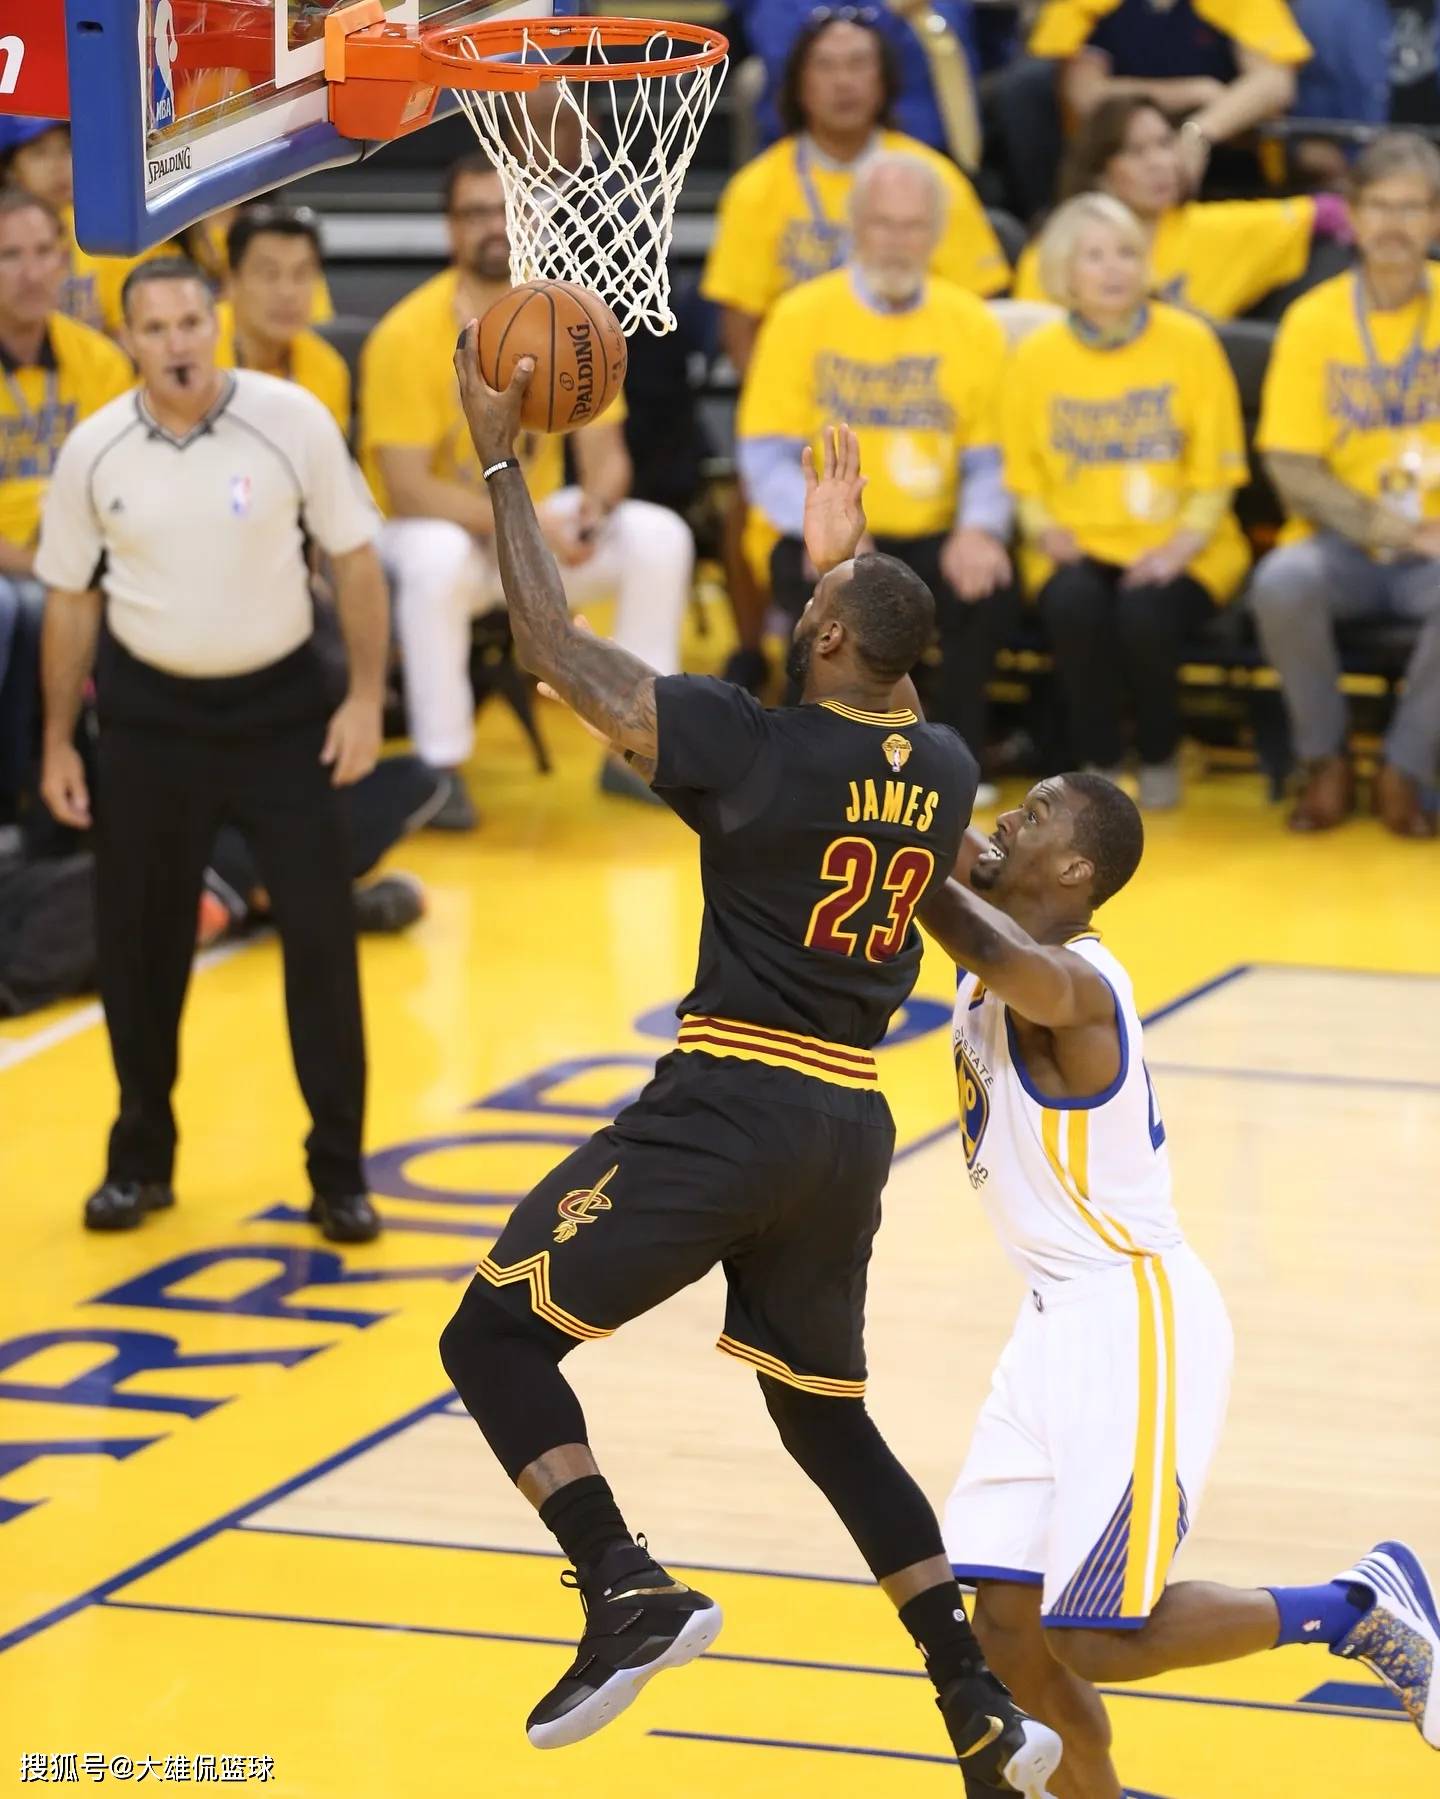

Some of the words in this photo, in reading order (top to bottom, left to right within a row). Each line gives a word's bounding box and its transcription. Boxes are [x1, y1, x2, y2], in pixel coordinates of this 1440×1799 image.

[156, 97, 171, 122] NBA
[148, 146, 192, 185] SPALDING
[566, 320, 593, 424] SPALDING
[845, 778, 940, 833] JAMES
[803, 835, 936, 964] 23
[962, 1040, 994, 1090] STATE
